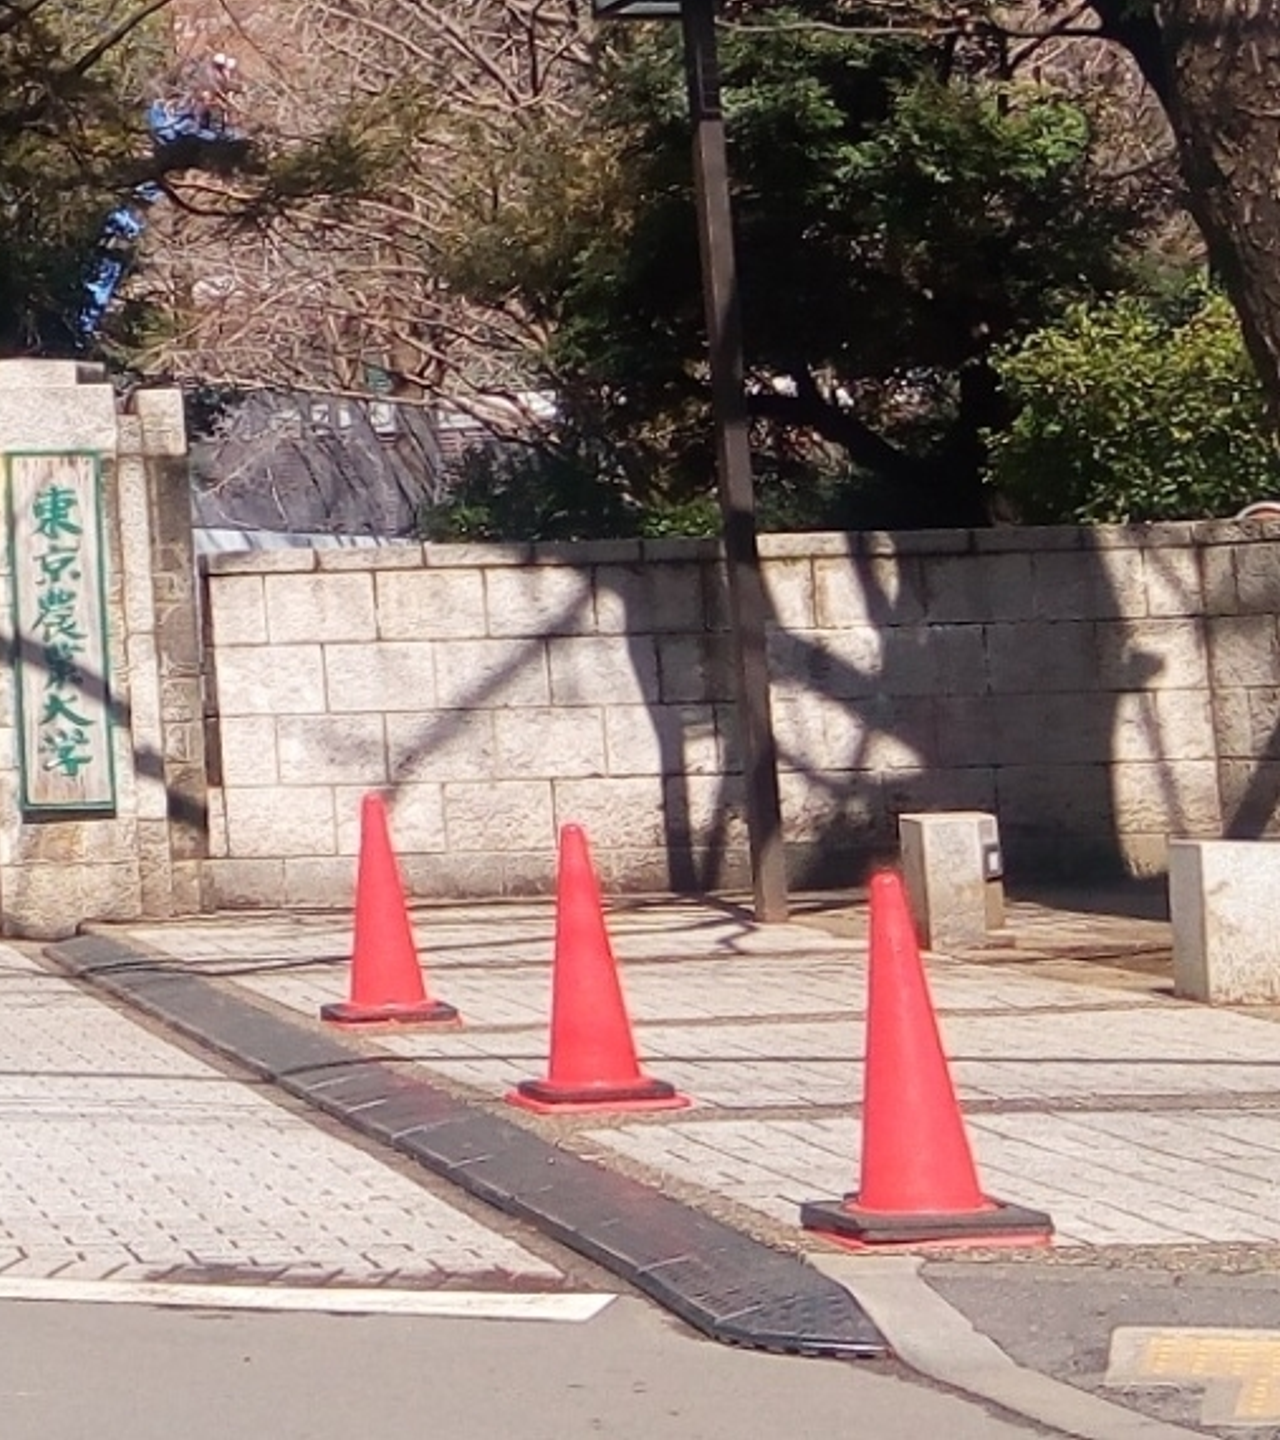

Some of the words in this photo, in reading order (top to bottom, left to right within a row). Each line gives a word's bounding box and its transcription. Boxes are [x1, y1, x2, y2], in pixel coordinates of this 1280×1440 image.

[30, 485, 97, 777] 東京農業大学
